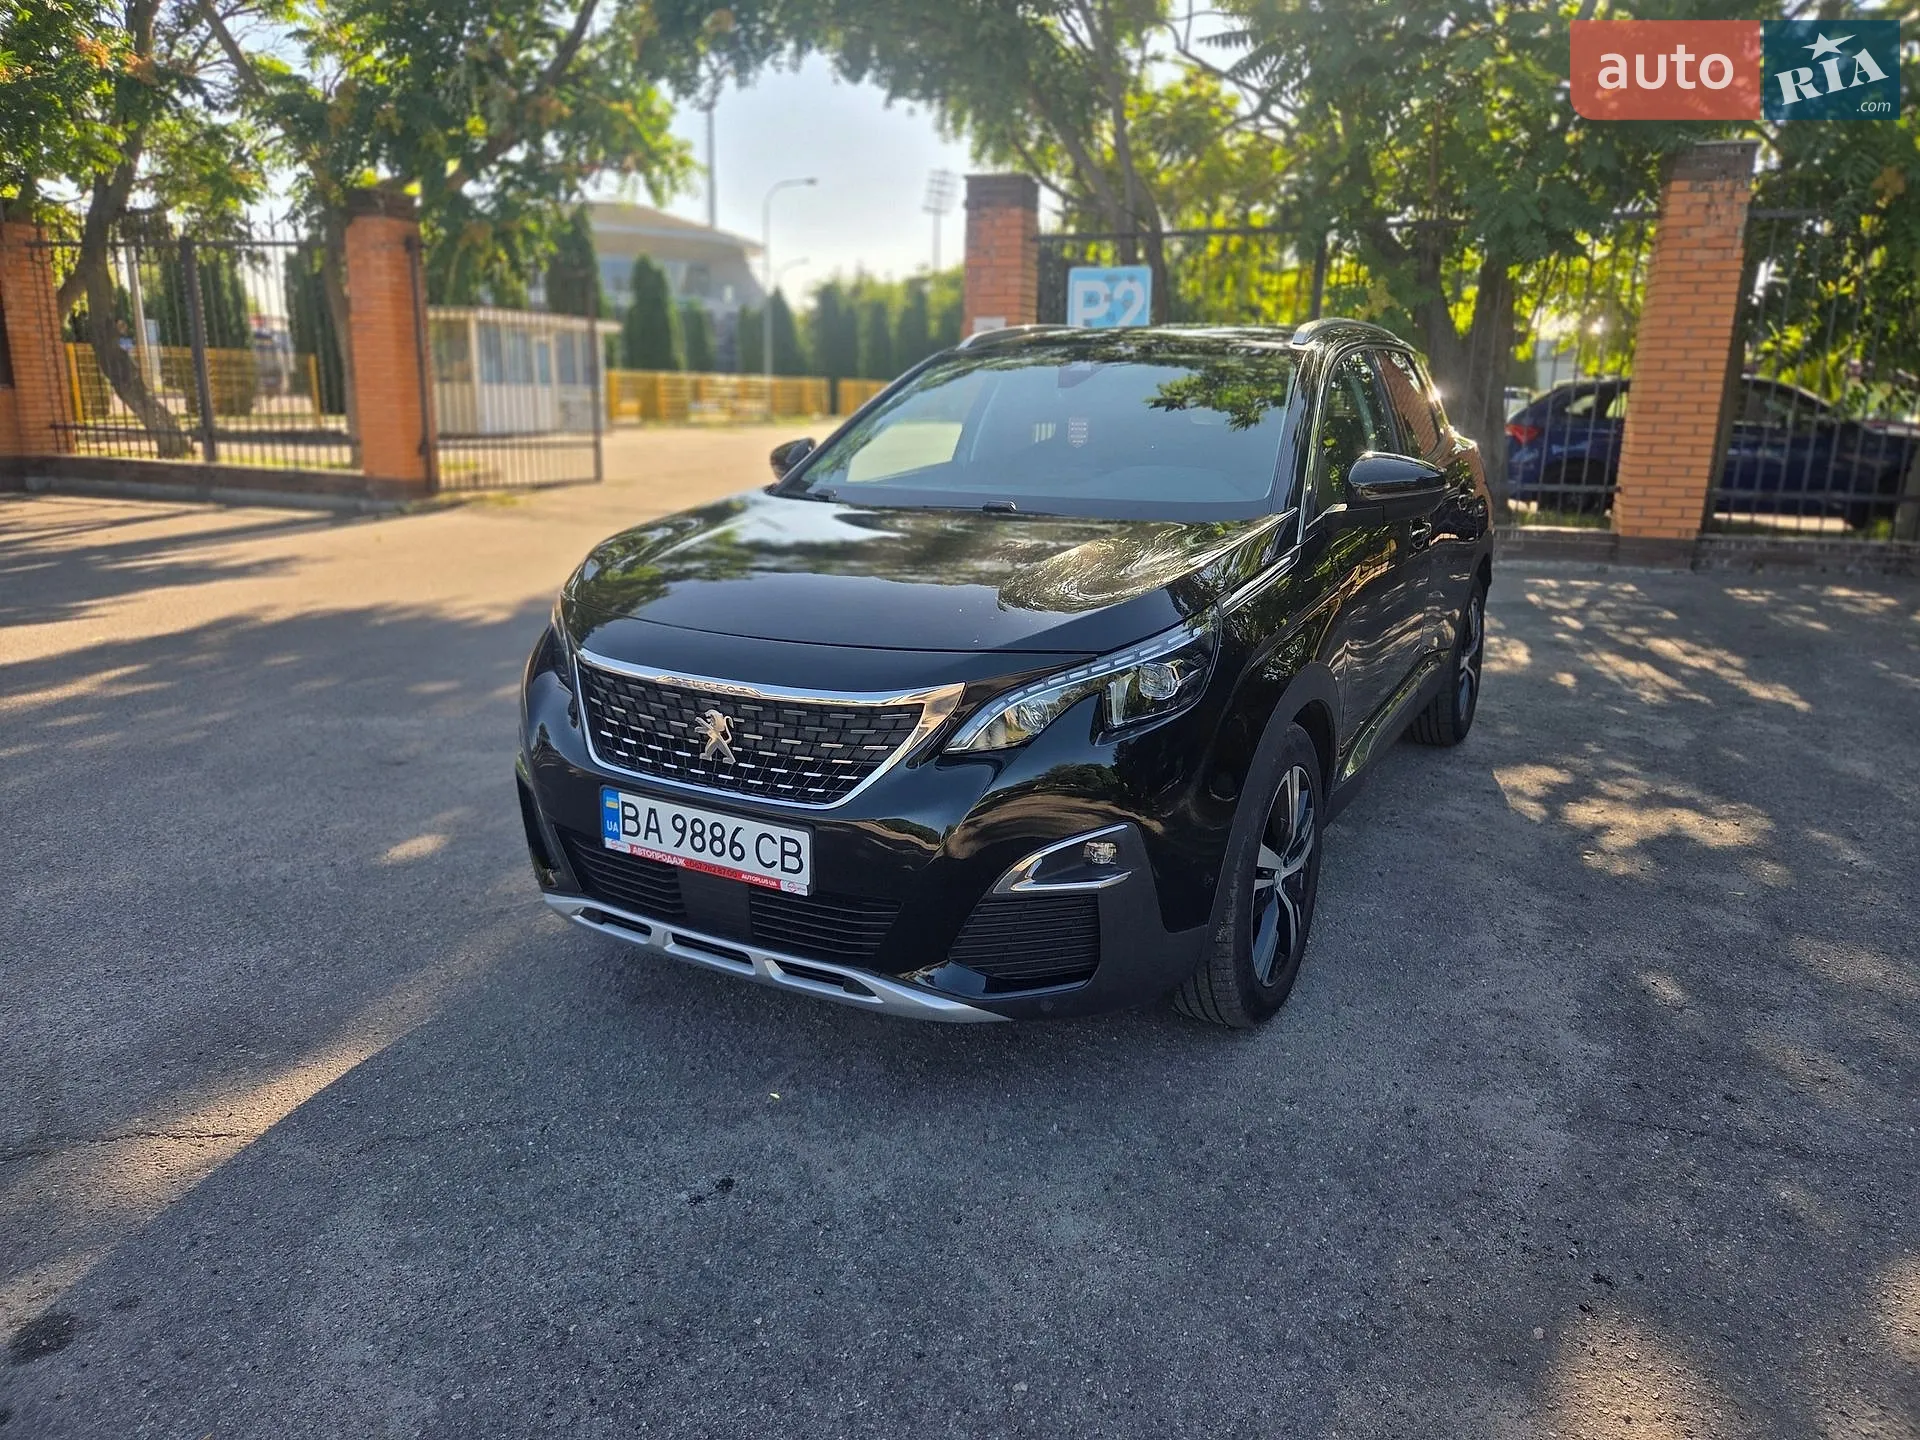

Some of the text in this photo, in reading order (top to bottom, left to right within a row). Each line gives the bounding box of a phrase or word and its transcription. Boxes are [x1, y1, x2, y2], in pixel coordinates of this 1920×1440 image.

[1074, 280, 1144, 327] P2
[606, 819, 619, 833] UA
[620, 800, 804, 875] BA 9886 CB
